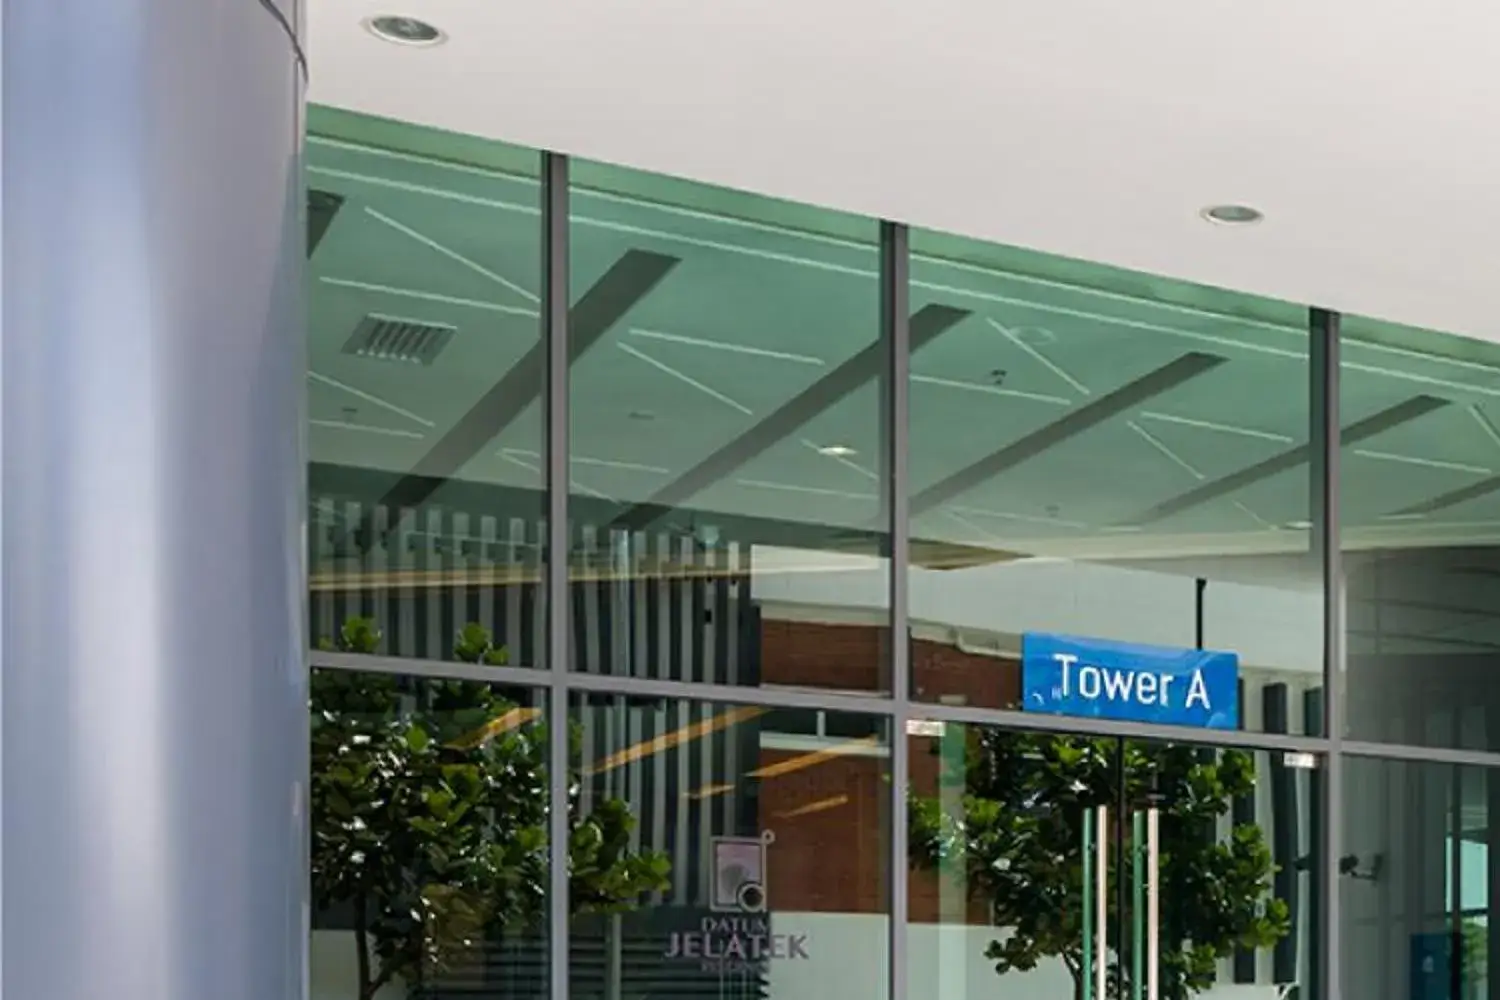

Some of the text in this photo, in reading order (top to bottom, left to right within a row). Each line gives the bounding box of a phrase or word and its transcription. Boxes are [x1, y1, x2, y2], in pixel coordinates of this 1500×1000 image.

[1053, 653, 1212, 710] Tower A
[665, 932, 809, 959] JELATEK
